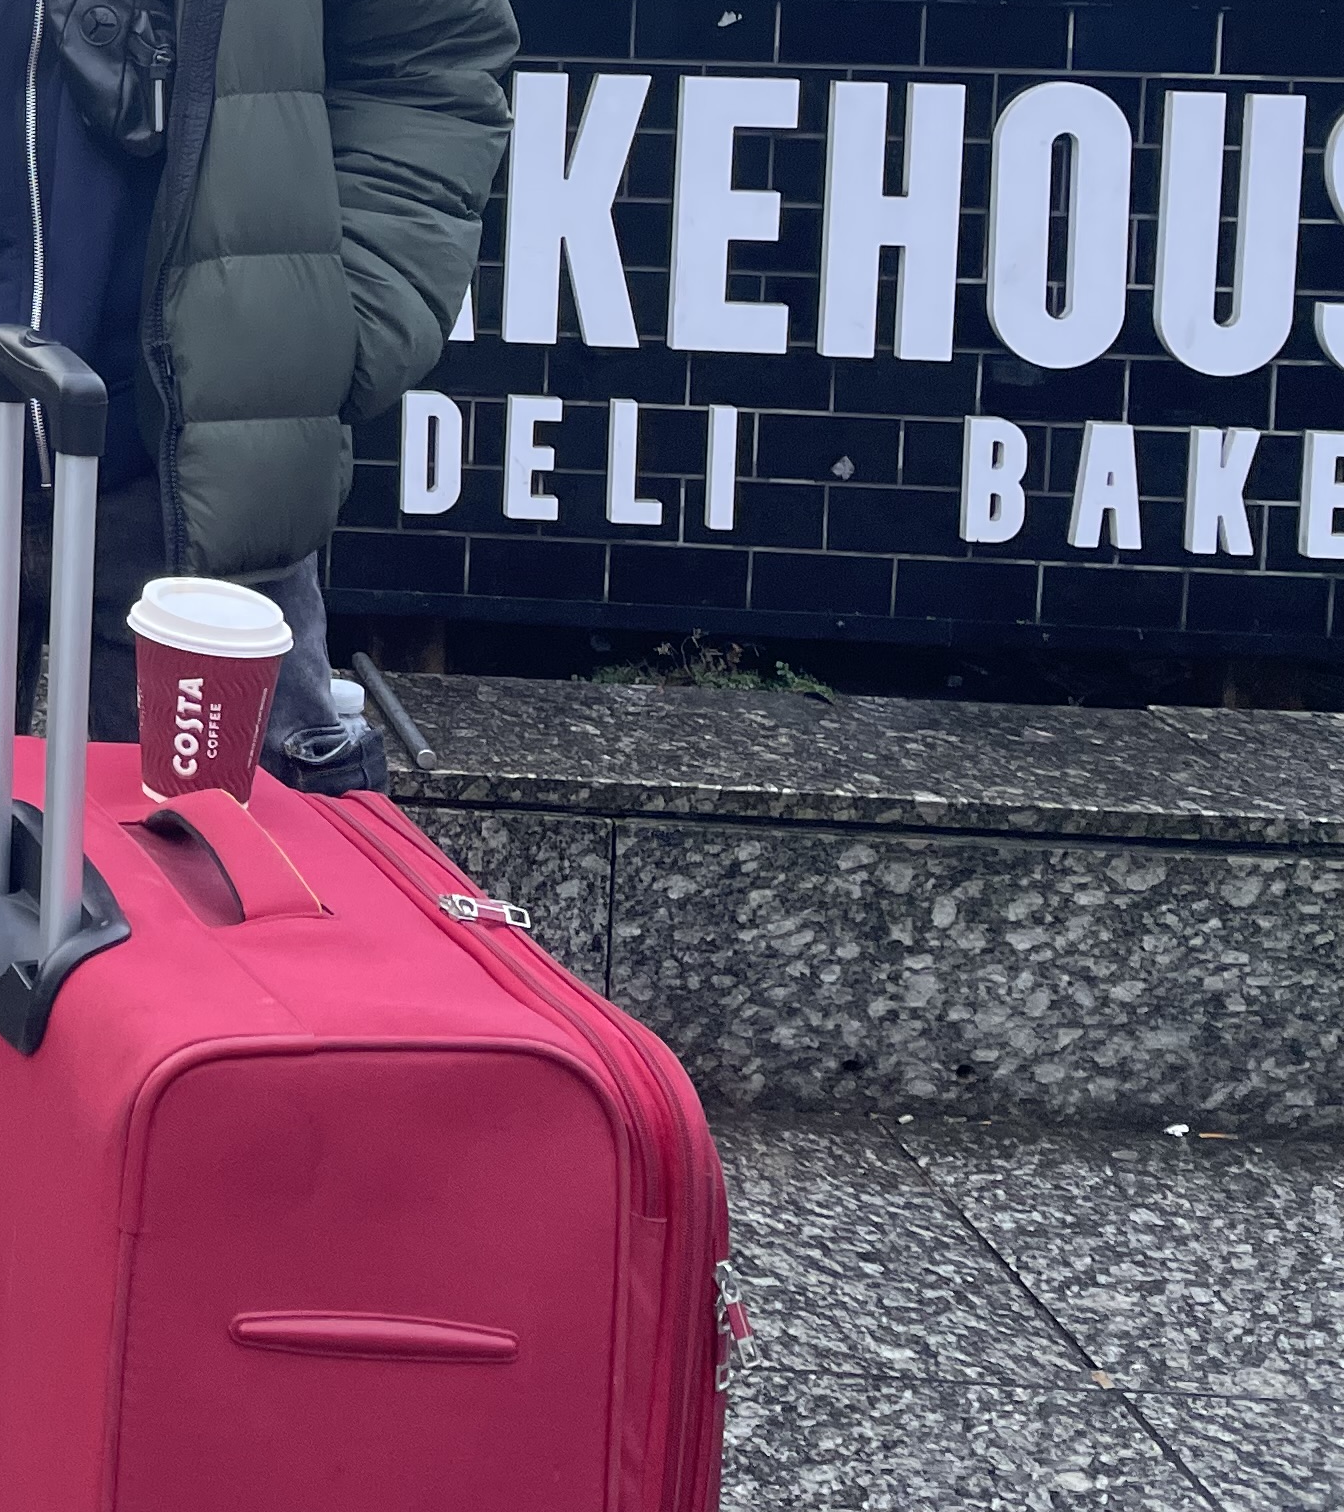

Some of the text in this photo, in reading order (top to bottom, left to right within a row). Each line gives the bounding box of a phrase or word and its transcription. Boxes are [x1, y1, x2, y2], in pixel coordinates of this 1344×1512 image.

[399, 389, 738, 531] DELI
[172, 677, 204, 778] COSTA
[207, 703, 222, 759] COFFEE
